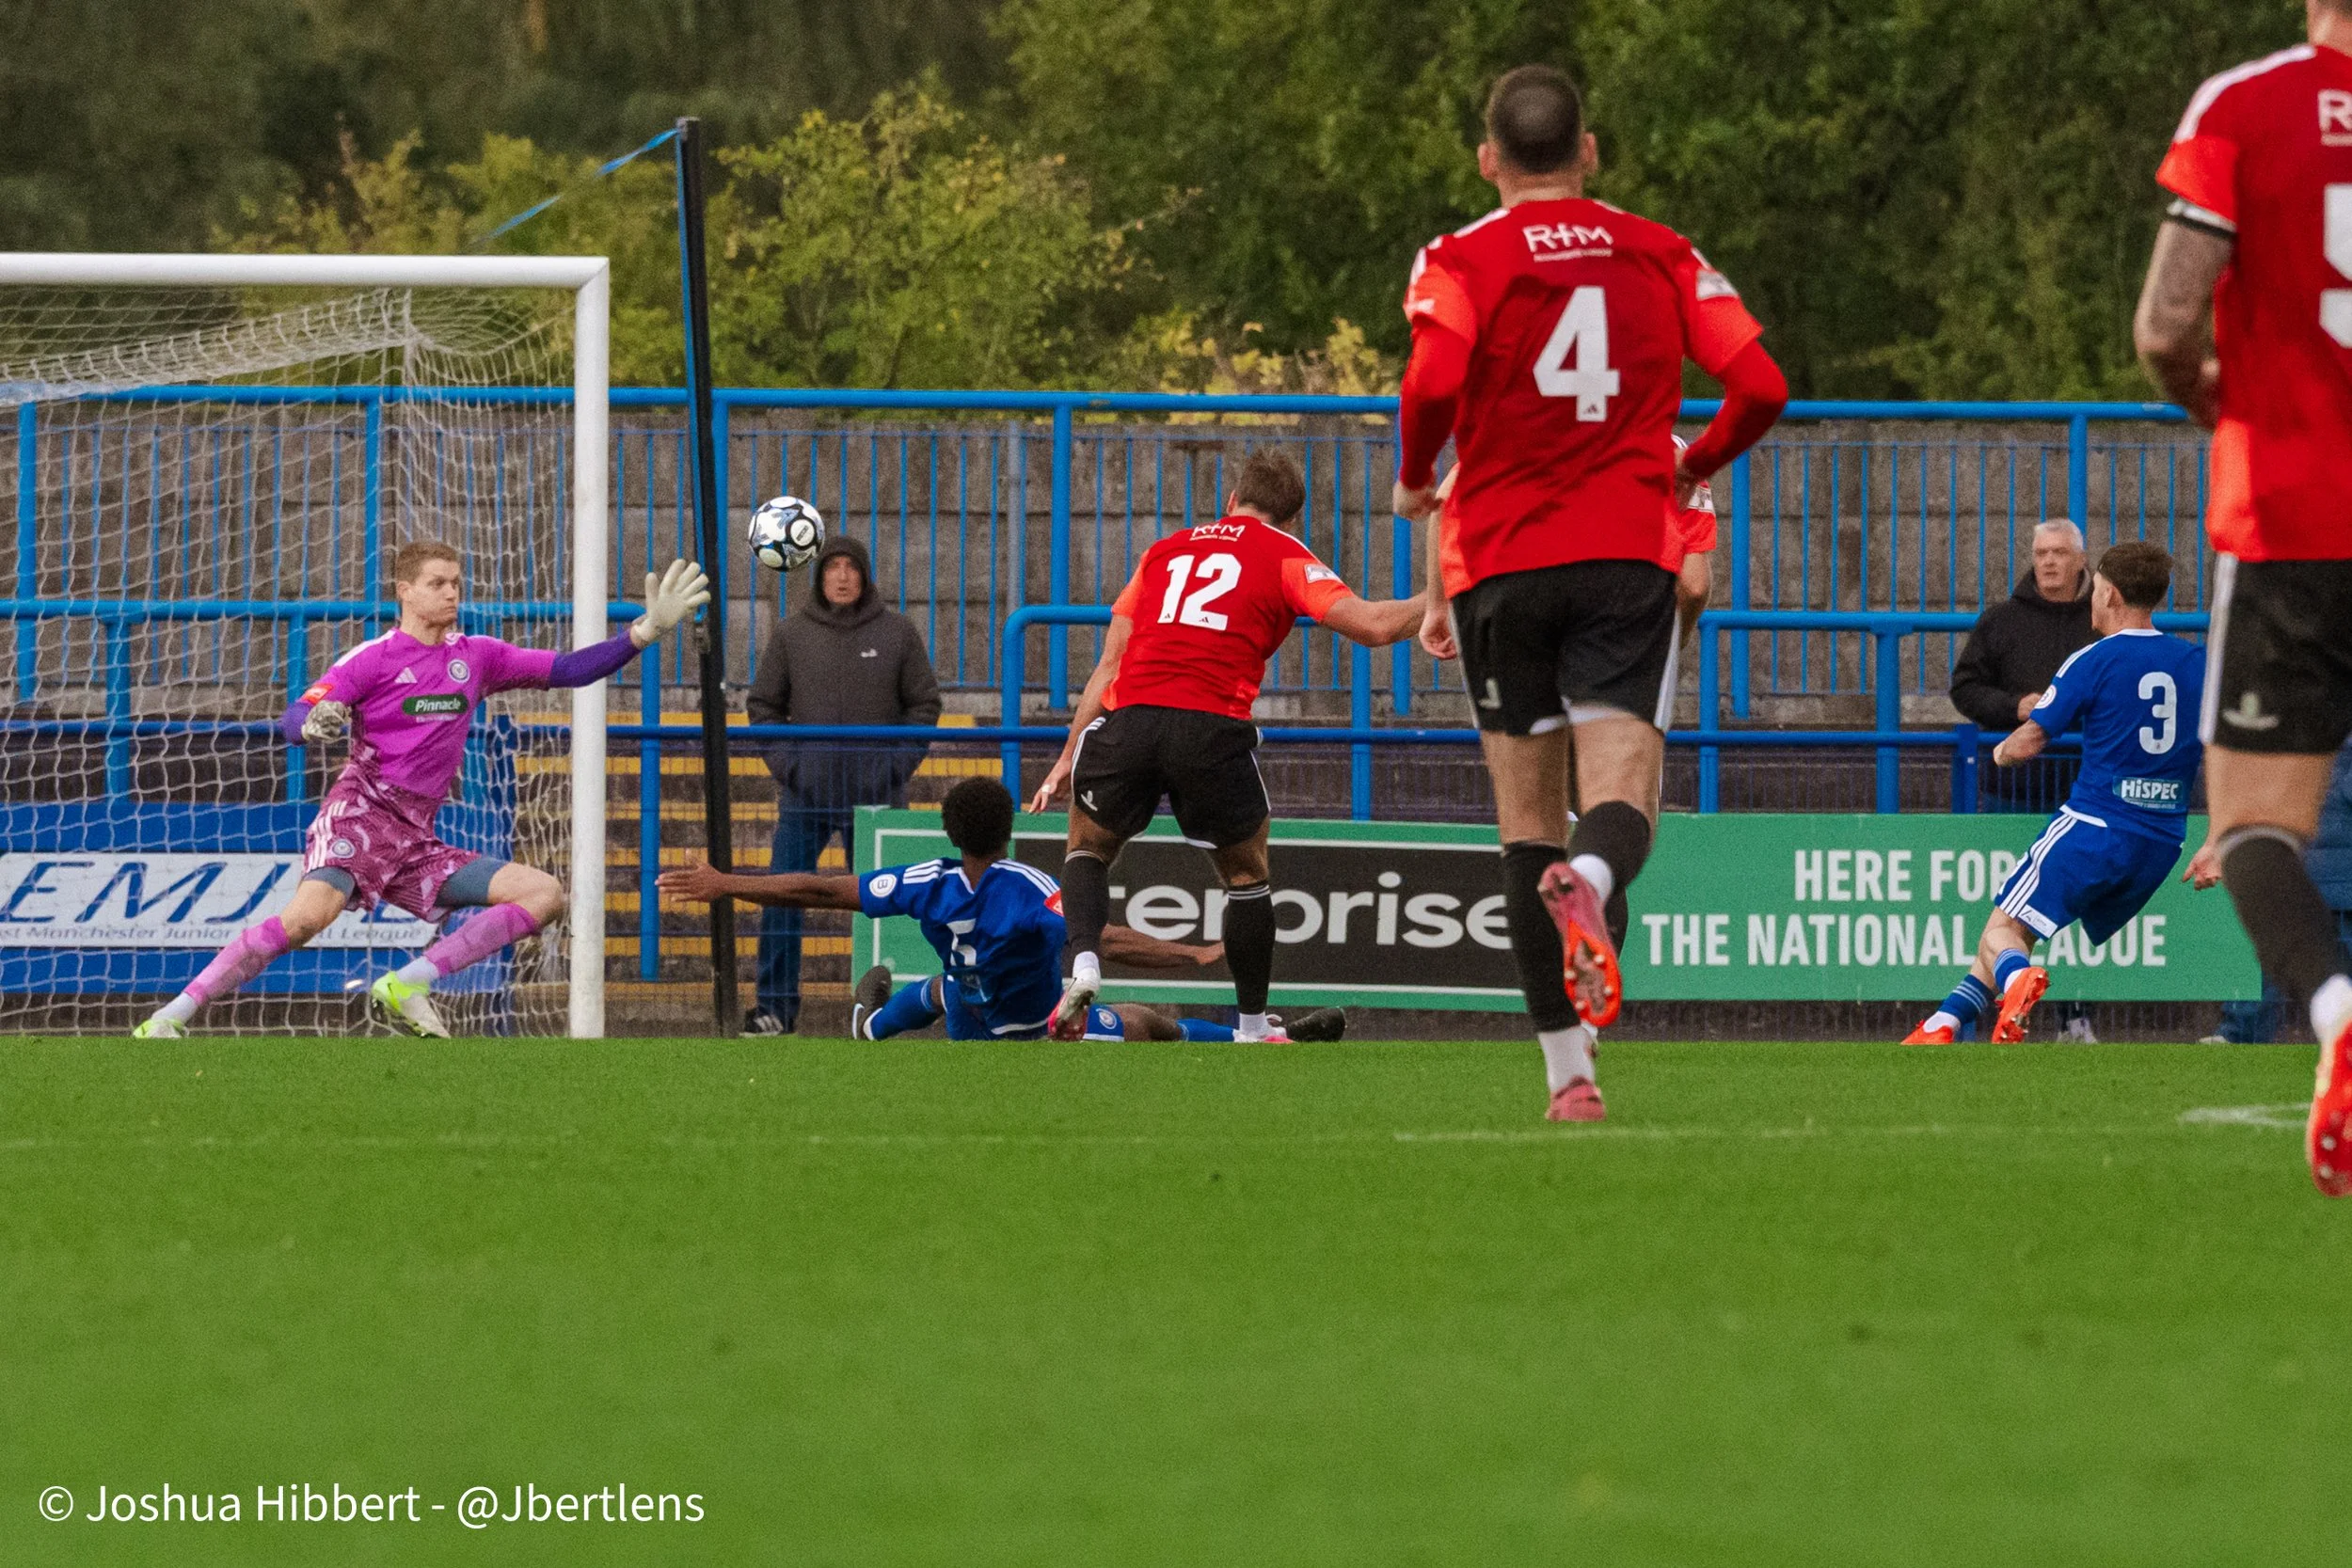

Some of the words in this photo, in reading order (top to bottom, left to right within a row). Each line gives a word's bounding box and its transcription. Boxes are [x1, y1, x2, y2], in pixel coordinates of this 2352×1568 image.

[1534, 285, 1620, 422] 4
[1157, 553, 1242, 631] 12
[2137, 671, 2177, 754] 3
[1794, 849, 1912, 901] HERE
[1642, 914, 1729, 966] THE
[1747, 914, 1976, 966] NATIONAL
